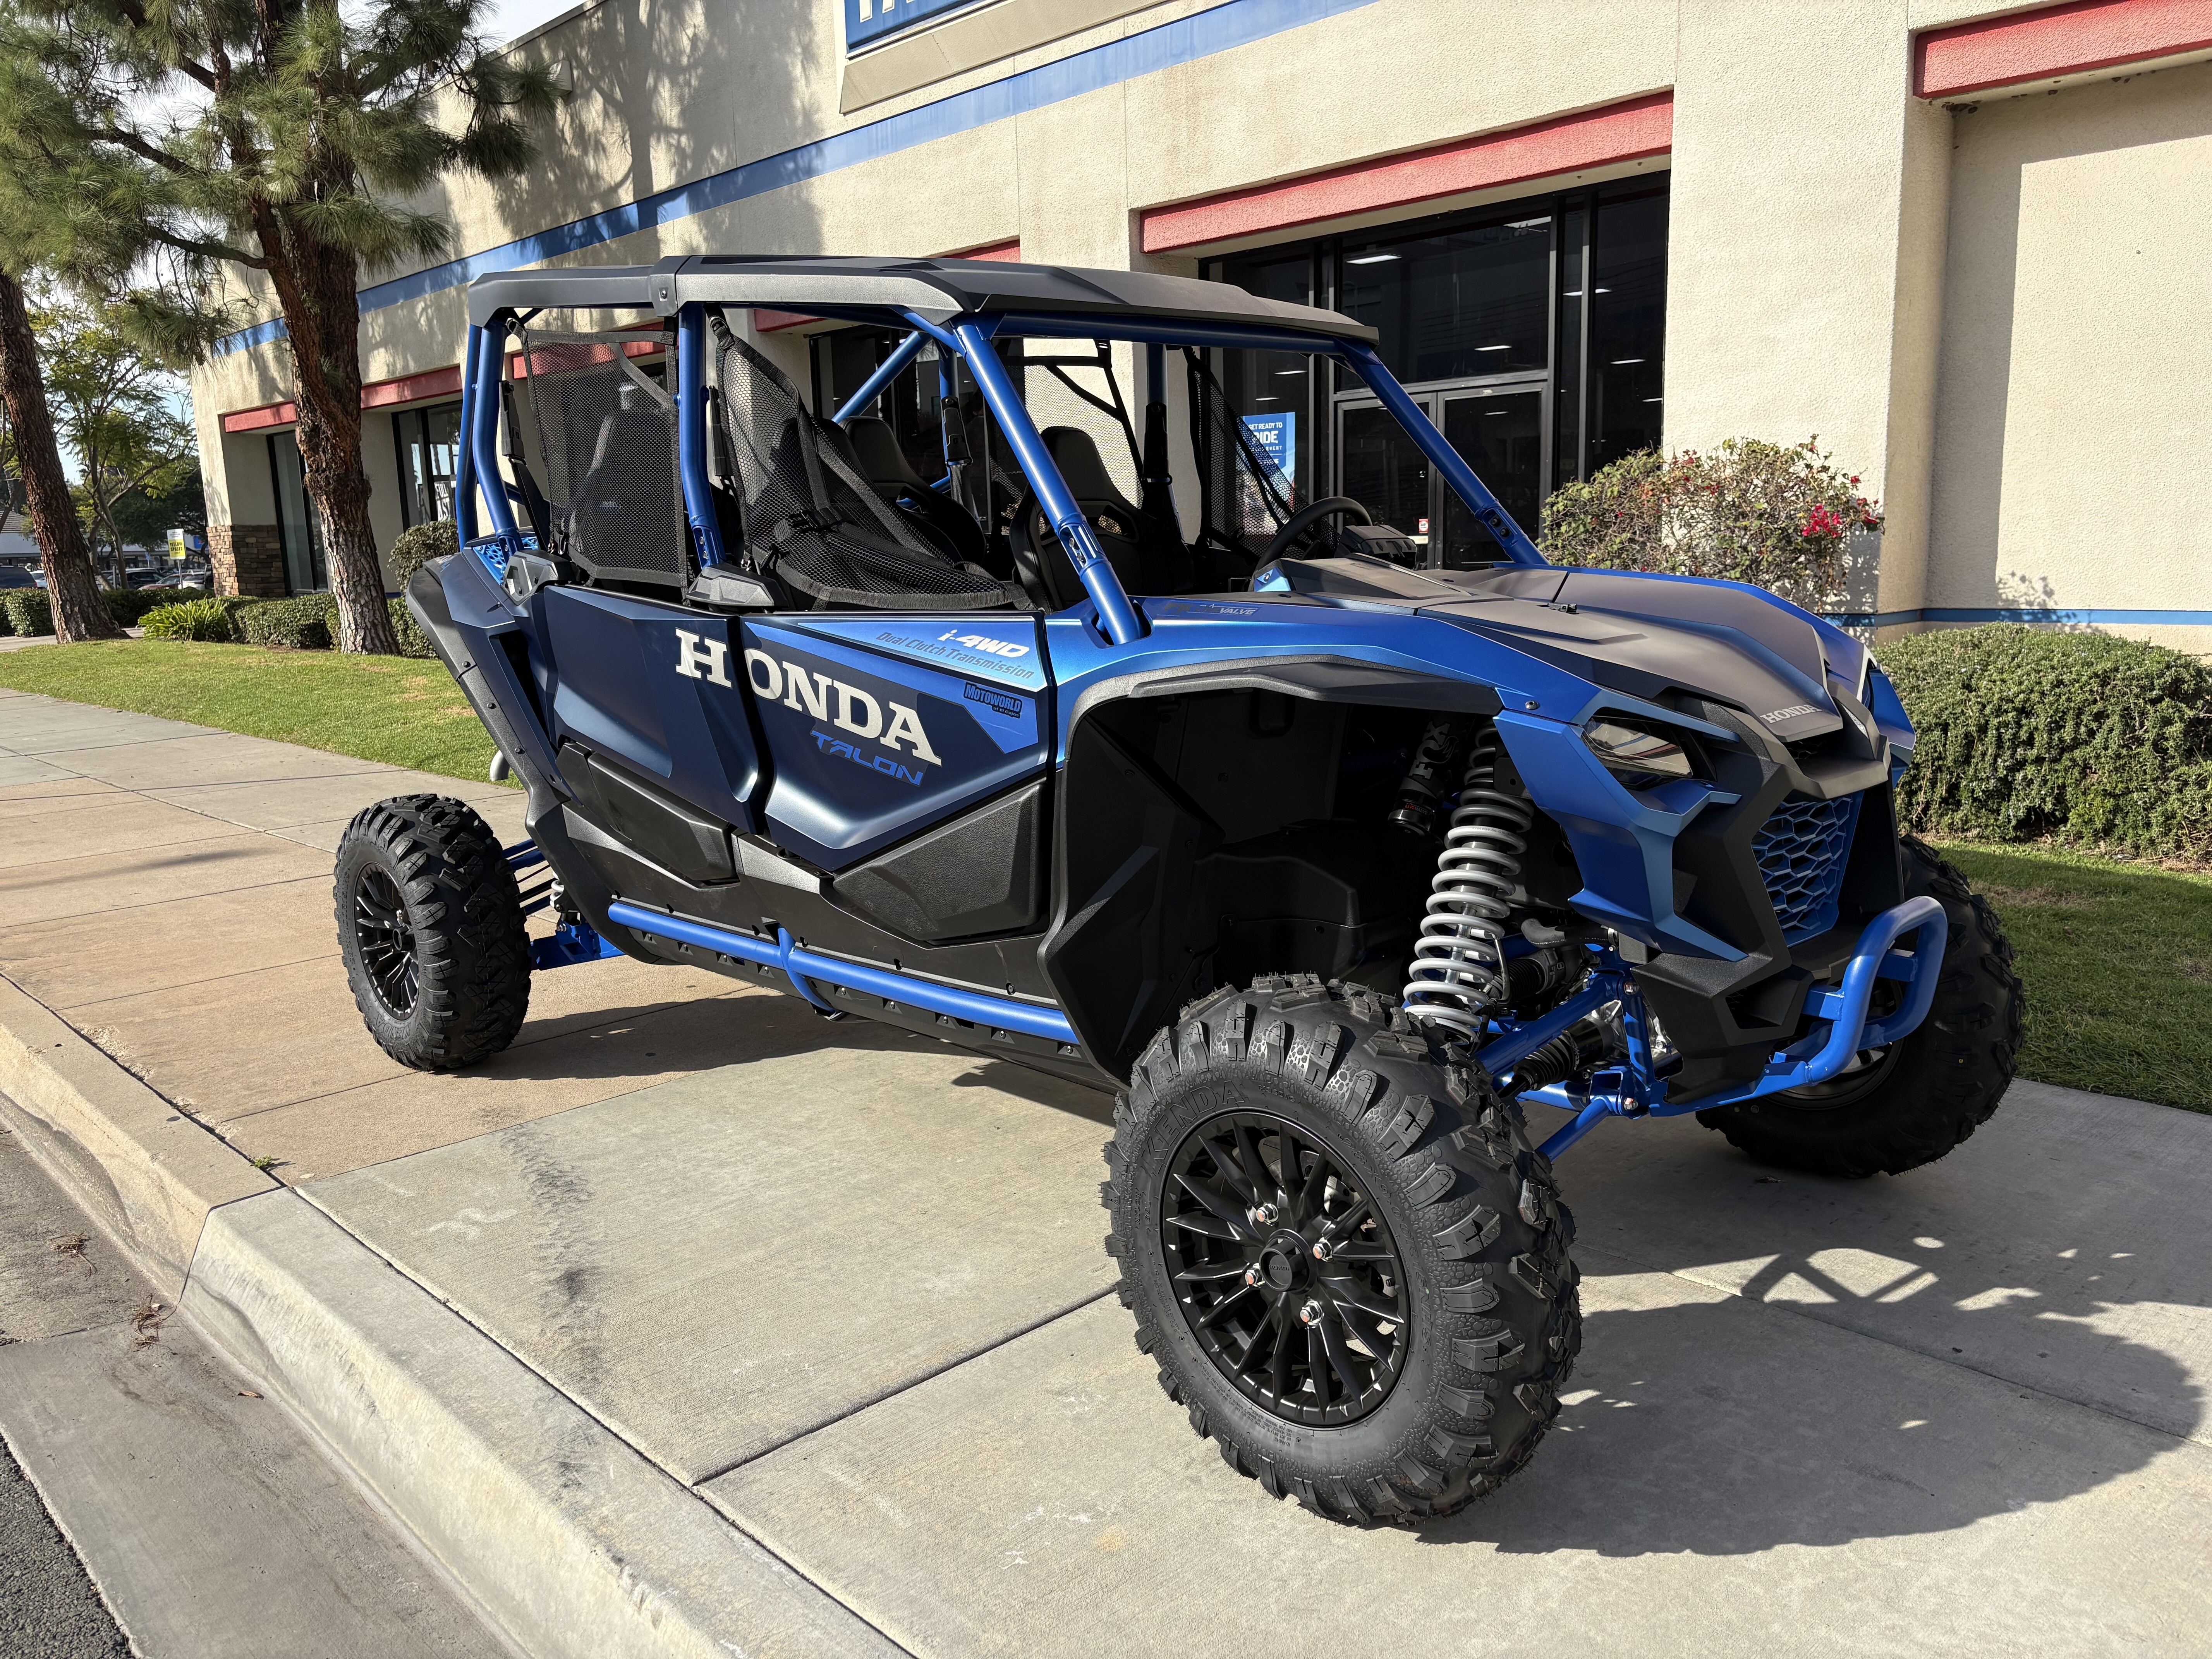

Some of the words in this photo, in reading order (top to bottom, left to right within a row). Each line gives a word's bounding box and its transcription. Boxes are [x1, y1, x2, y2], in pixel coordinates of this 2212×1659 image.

[876, 632, 905, 645] Dual
[905, 640, 946, 655] Clutch
[946, 648, 1034, 678] Transmission
[938, 629, 1030, 658] i-4WD
[675, 628, 943, 767] HONDA
[965, 684, 1021, 712] MOTOWORLD
[1759, 704, 1822, 724] HONDA
[811, 730, 923, 785] TALON
[1409, 721, 1452, 779] FOX
[376, 1013, 410, 1039] KENDA
[1141, 1080, 1245, 1174] KENDA
